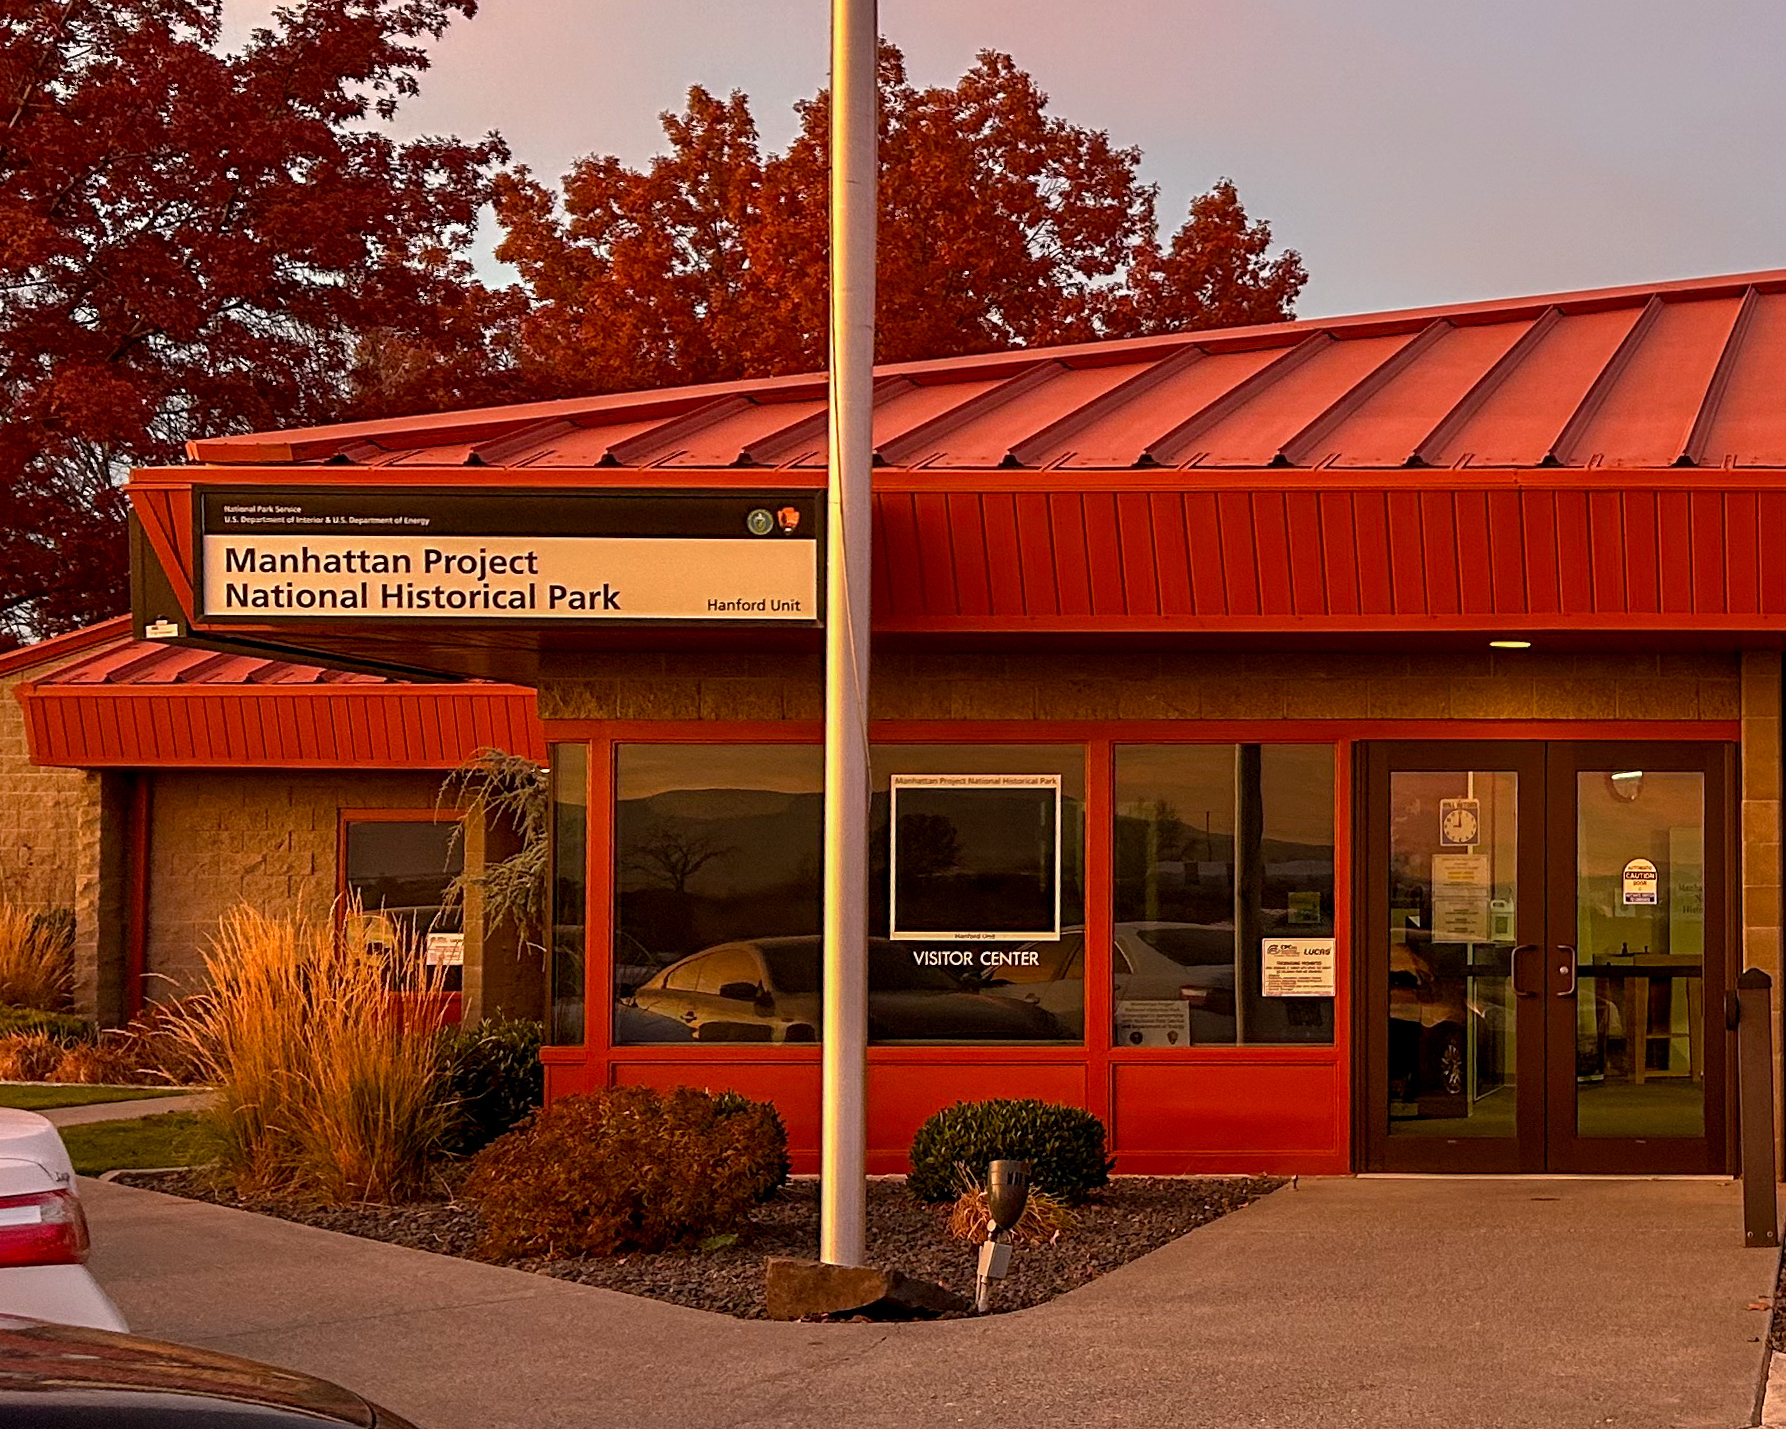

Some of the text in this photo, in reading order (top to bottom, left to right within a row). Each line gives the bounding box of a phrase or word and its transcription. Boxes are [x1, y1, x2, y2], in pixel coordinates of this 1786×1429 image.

[257, 505, 273, 513] Park
[275, 505, 302, 514] Service
[240, 516, 286, 525] Department
[286, 516, 296, 524] of
[349, 517, 394, 525] Department
[394, 516, 403, 524] of
[403, 517, 430, 526] Energy
[225, 547, 539, 582] Manhattan Project
[225, 582, 622, 611] National Historical Park
[707, 599, 802, 612] Hanford Unit
[895, 777, 938, 785] Manhattan
[913, 951, 1040, 966] VISITOR CENTER
